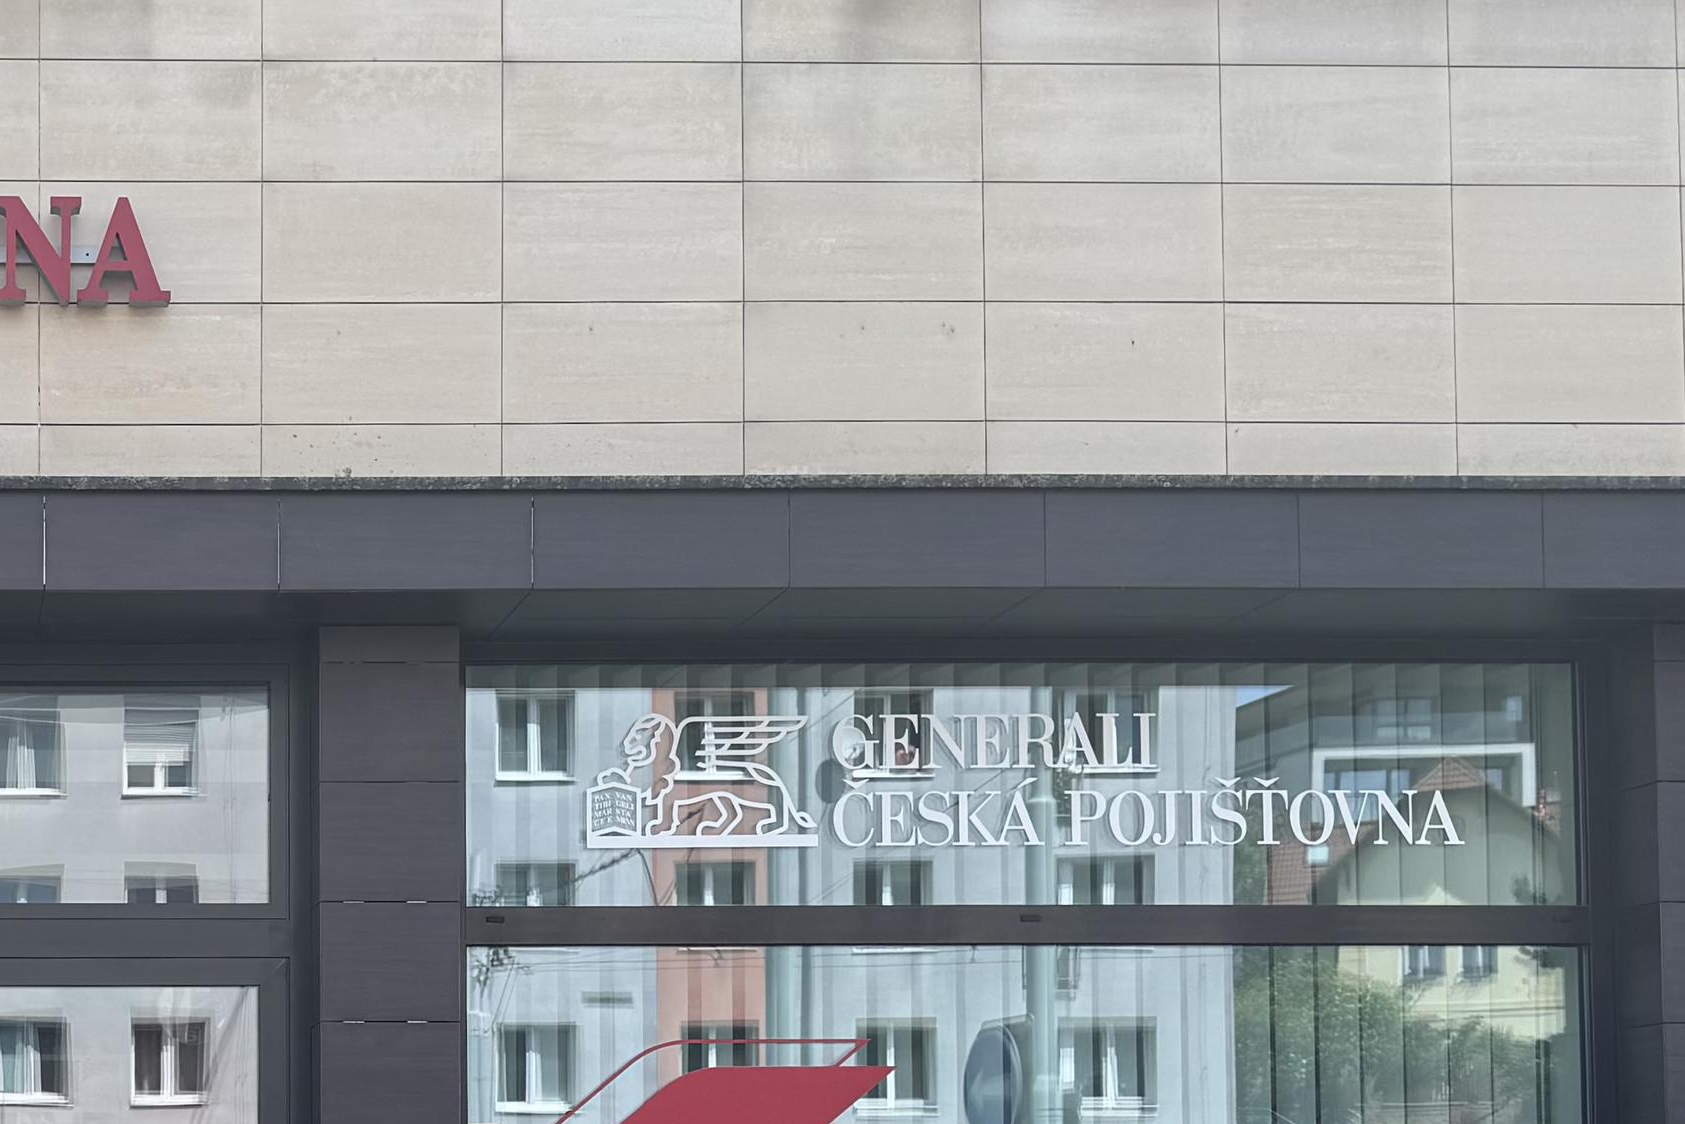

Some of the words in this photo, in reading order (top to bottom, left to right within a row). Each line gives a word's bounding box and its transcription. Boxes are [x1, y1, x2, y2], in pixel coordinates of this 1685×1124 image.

[832, 712, 1157, 769] GENERALI
[832, 778, 1045, 847] ČESKÁ
[1063, 776, 1466, 846] POJIŠŤOVNA
